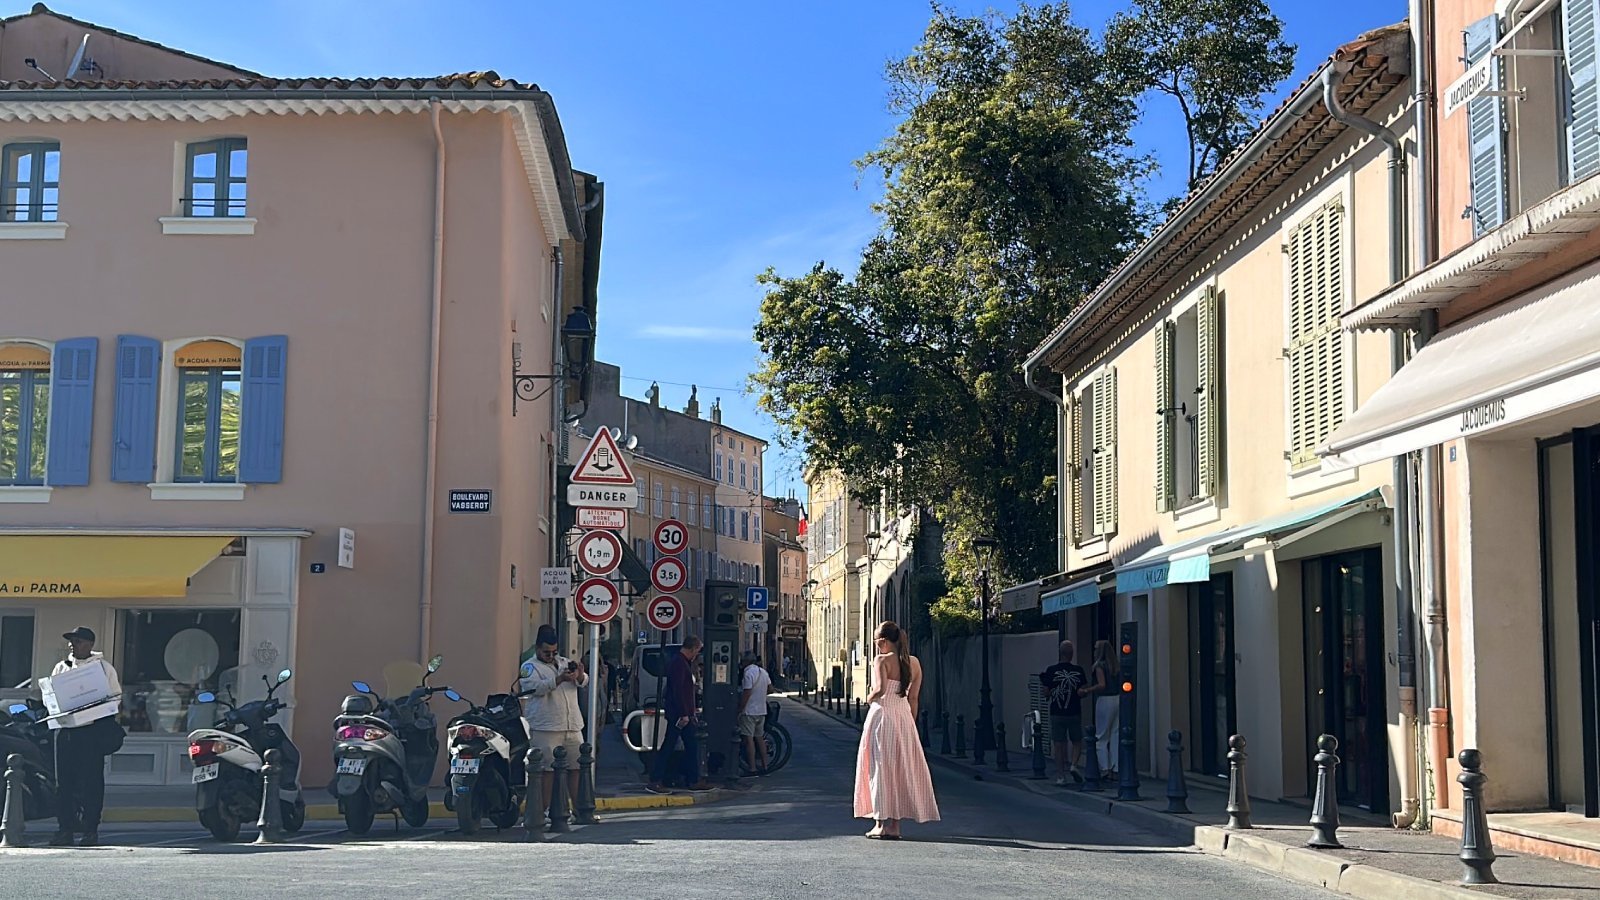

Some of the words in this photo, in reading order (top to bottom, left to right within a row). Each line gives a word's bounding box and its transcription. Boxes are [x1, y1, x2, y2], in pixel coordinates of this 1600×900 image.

[1449, 66, 1486, 111] JACQUEMUS
[1460, 398, 1506, 432] JACQUEMUS
[452, 493, 489, 501] BOULEVARD
[580, 490, 627, 502] DANGER
[451, 501, 489, 509] VASSEROT
[660, 528, 682, 545] 30
[314, 564, 320, 572] 2
[660, 569, 678, 581] 3,5t
[30, 583, 82, 593] PARMA
[586, 594, 608, 606] 2,5m
[752, 591, 763, 606] P
